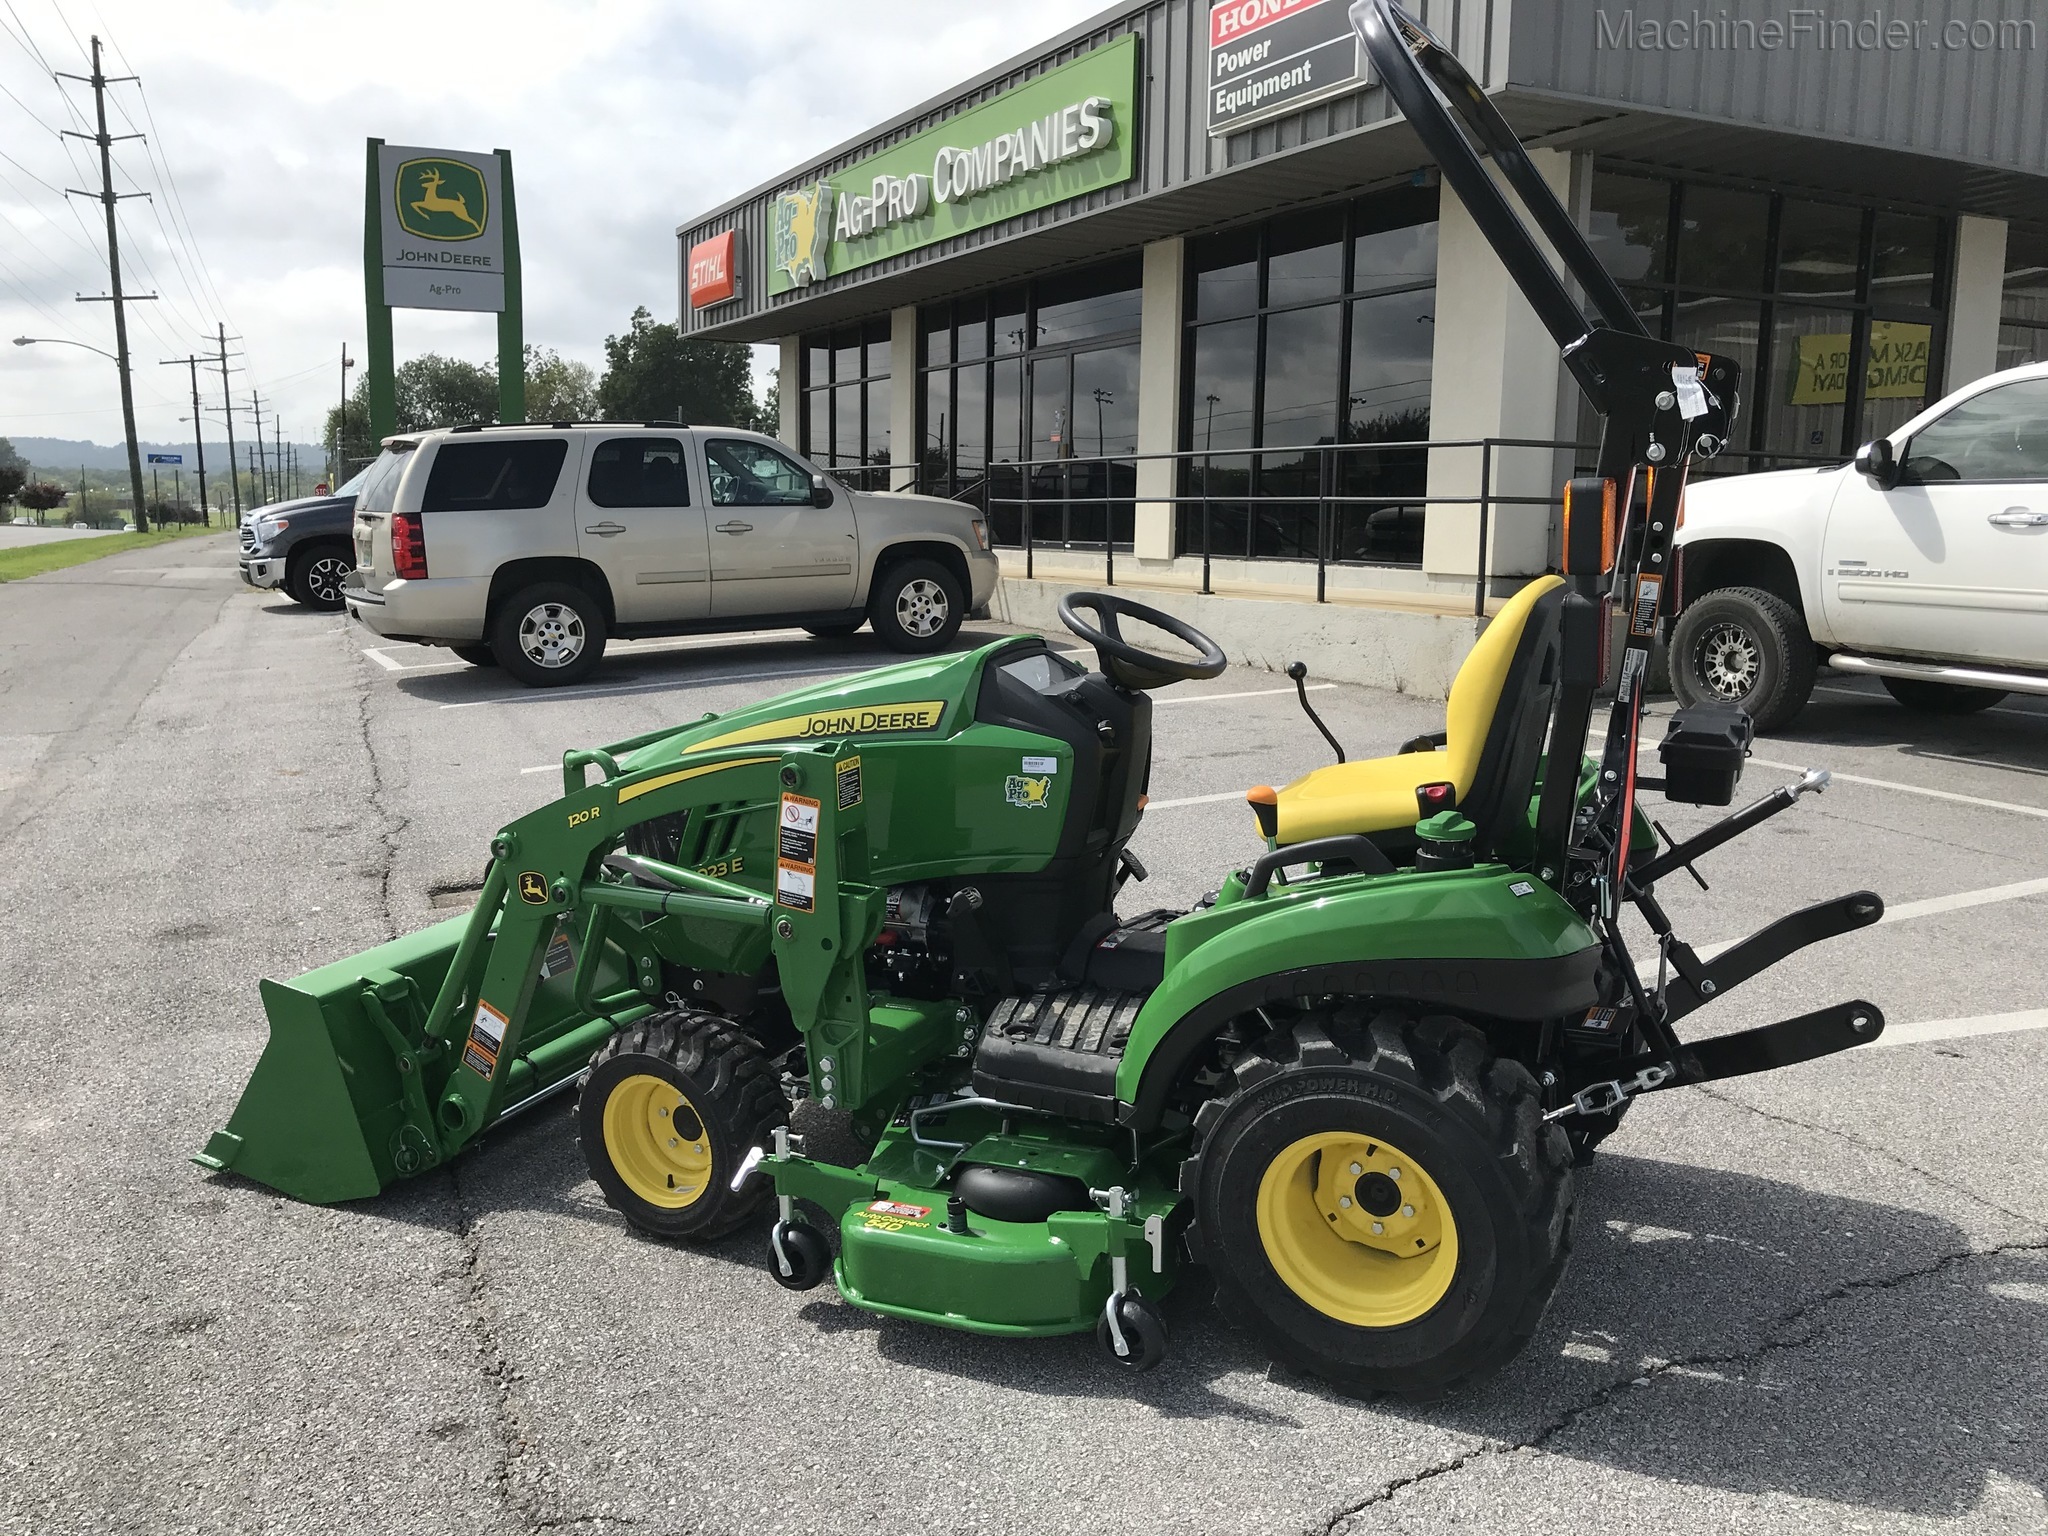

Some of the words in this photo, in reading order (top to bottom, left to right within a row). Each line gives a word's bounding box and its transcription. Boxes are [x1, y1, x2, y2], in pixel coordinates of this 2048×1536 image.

[1216, 39, 1272, 77] Power
[1215, 59, 1312, 114] Equipment
[933, 96, 1109, 204] COMPANIES
[396, 249, 438, 263] JOHN
[441, 251, 492, 267] DEERE
[691, 253, 724, 290] STIHL
[429, 284, 462, 295] Ag-Pro
[800, 717, 856, 735] JOHN
[860, 712, 930, 730] DEERE
[789, 796, 819, 808] WARNING
[1008, 788, 1029, 799] Pro
[567, 810, 590, 829] 120
[590, 806, 601, 819] R
[731, 857, 744, 873] E
[784, 864, 814, 875] WARNING
[1296, 1078, 1359, 1093] POWER
[864, 1219, 905, 1231] 54D
